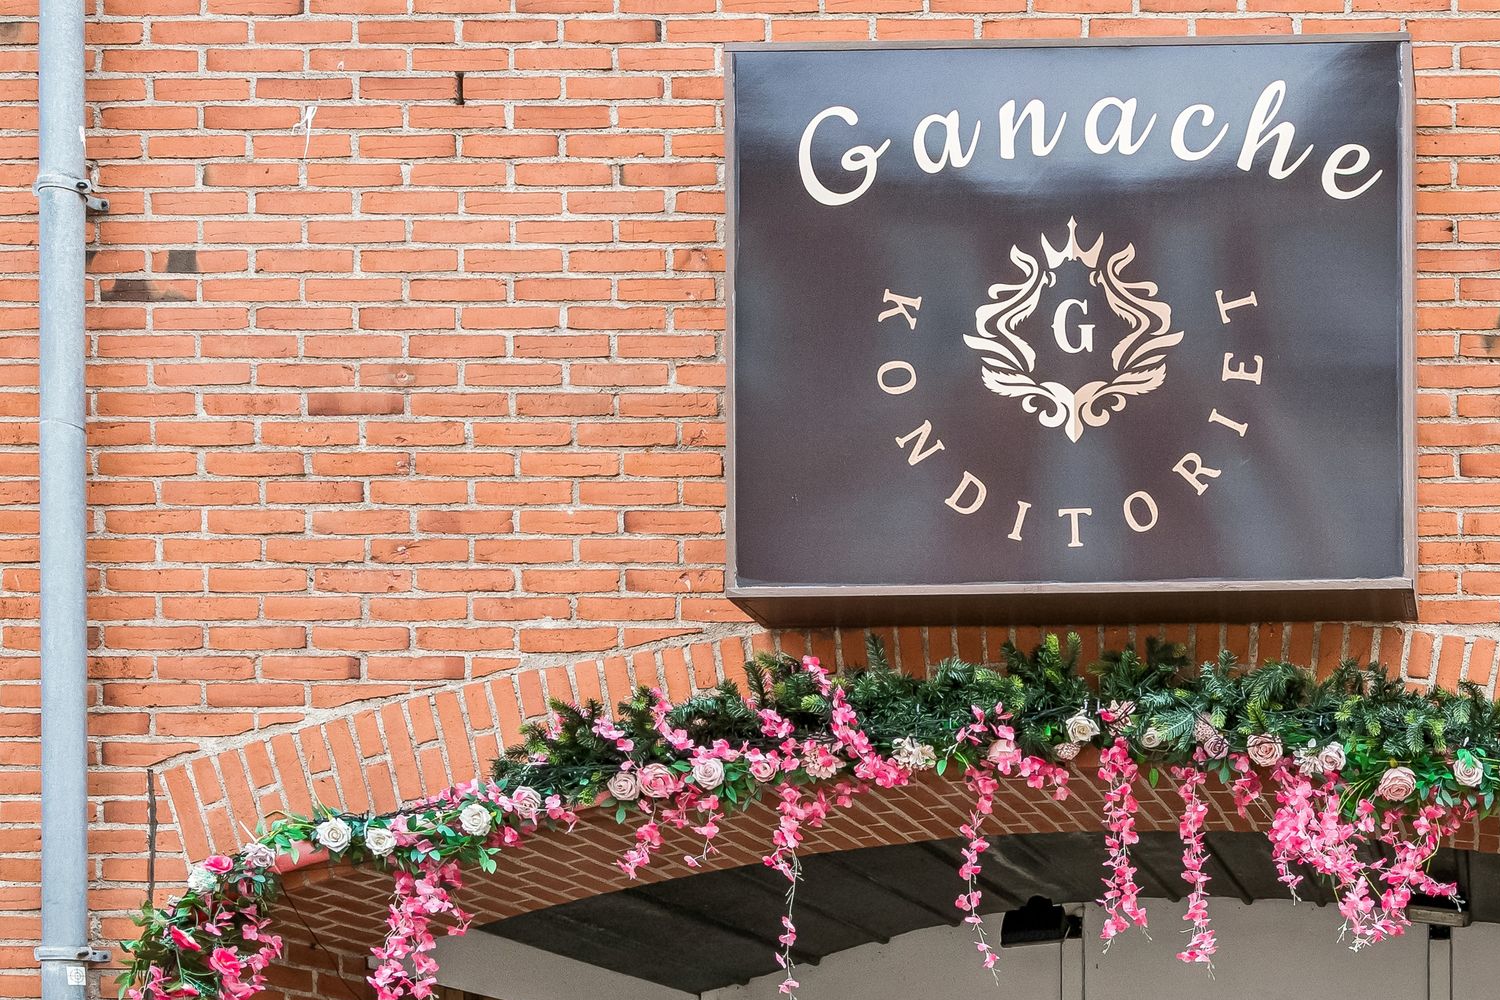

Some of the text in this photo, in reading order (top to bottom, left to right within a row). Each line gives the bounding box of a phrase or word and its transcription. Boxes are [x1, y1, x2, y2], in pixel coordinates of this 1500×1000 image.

[798, 79, 1384, 206] Ganache
[1051, 298, 1095, 354] G
[876, 288, 1264, 548] KONDITORIET
